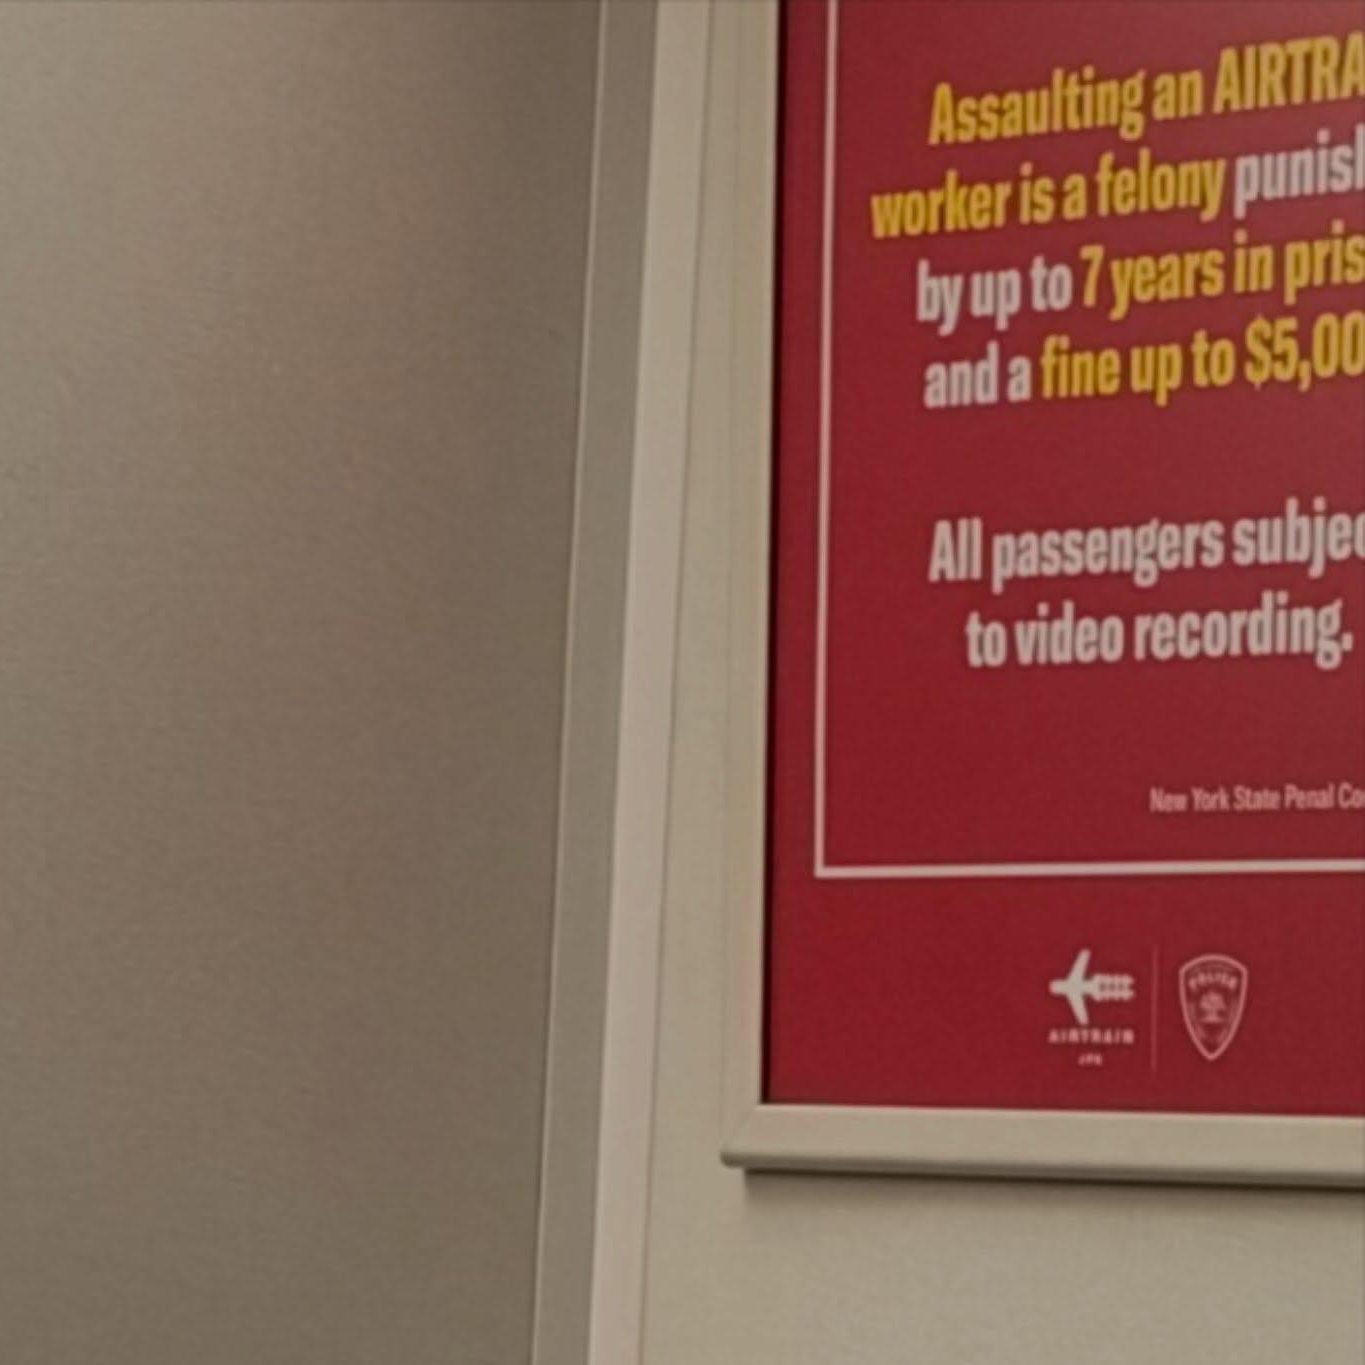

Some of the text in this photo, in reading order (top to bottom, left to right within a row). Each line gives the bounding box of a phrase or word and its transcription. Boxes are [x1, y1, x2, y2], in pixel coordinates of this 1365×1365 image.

[929, 30, 1365, 143] Assaulting an AIRTRA
[872, 170, 1012, 238] worker
[1021, 163, 1054, 223] is
[1063, 174, 1086, 219] a
[1096, 148, 1226, 222] felony
[917, 219, 1365, 335] by up to 7 years in pris
[924, 311, 1365, 408] and a fine up to $5,00
[929, 517, 982, 582] All
[992, 516, 1223, 594] passengers
[966, 590, 1352, 668] to video recording.
[1150, 787, 1187, 812] New
[1191, 786, 1230, 811] York
[1233, 784, 1280, 810] State
[1284, 783, 1335, 809] Penal
